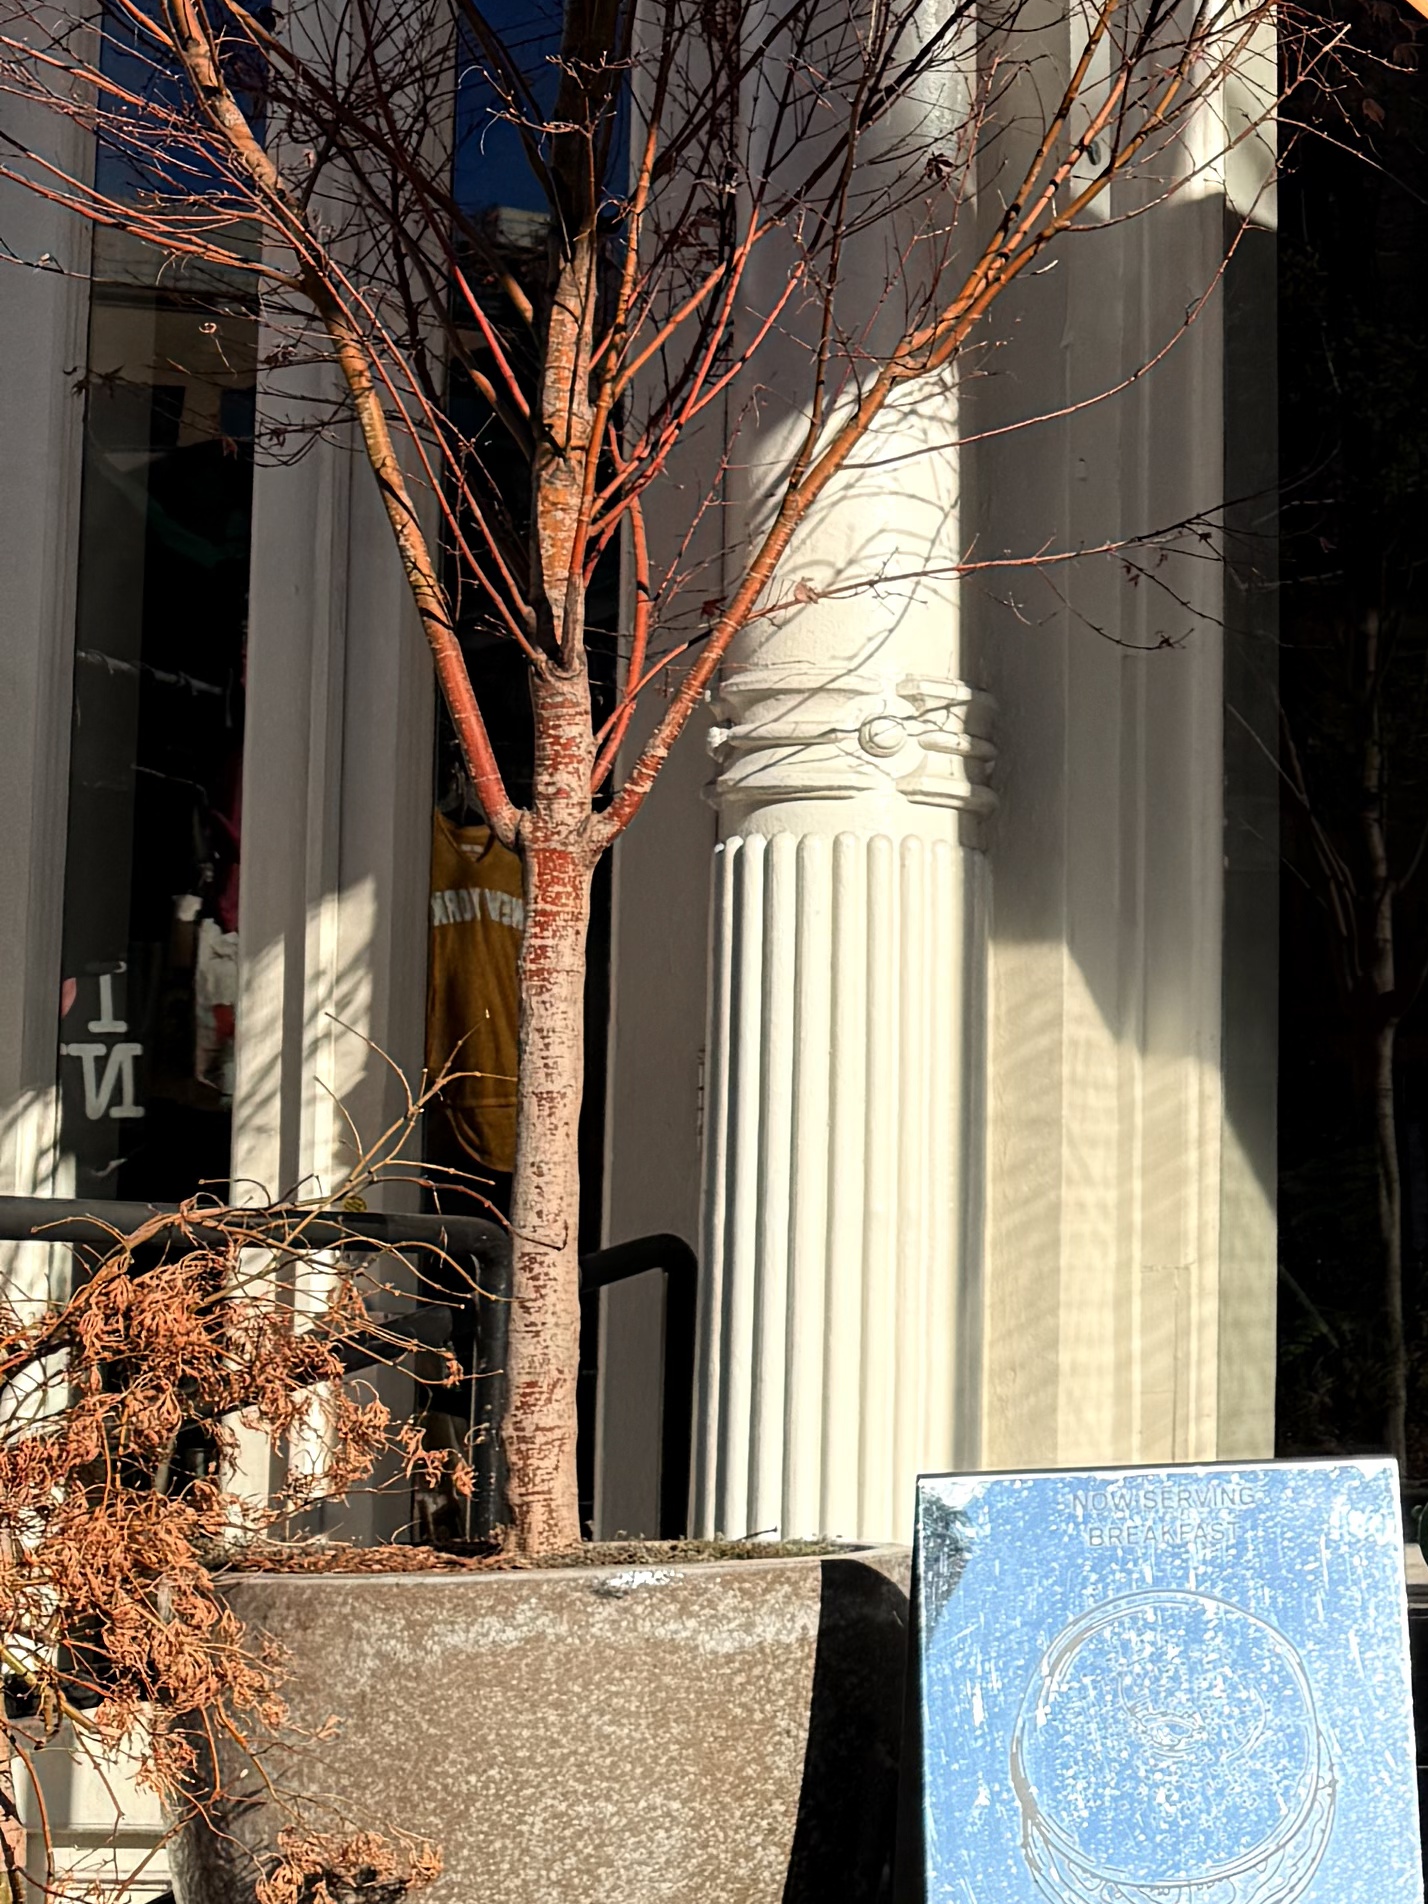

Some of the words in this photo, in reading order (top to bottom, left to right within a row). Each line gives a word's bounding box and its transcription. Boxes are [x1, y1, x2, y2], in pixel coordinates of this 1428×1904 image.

[1071, 1491, 1134, 1512] NOW
[1143, 1486, 1255, 1510] SERVING
[1088, 1521, 1240, 1547] BREAKFAST
